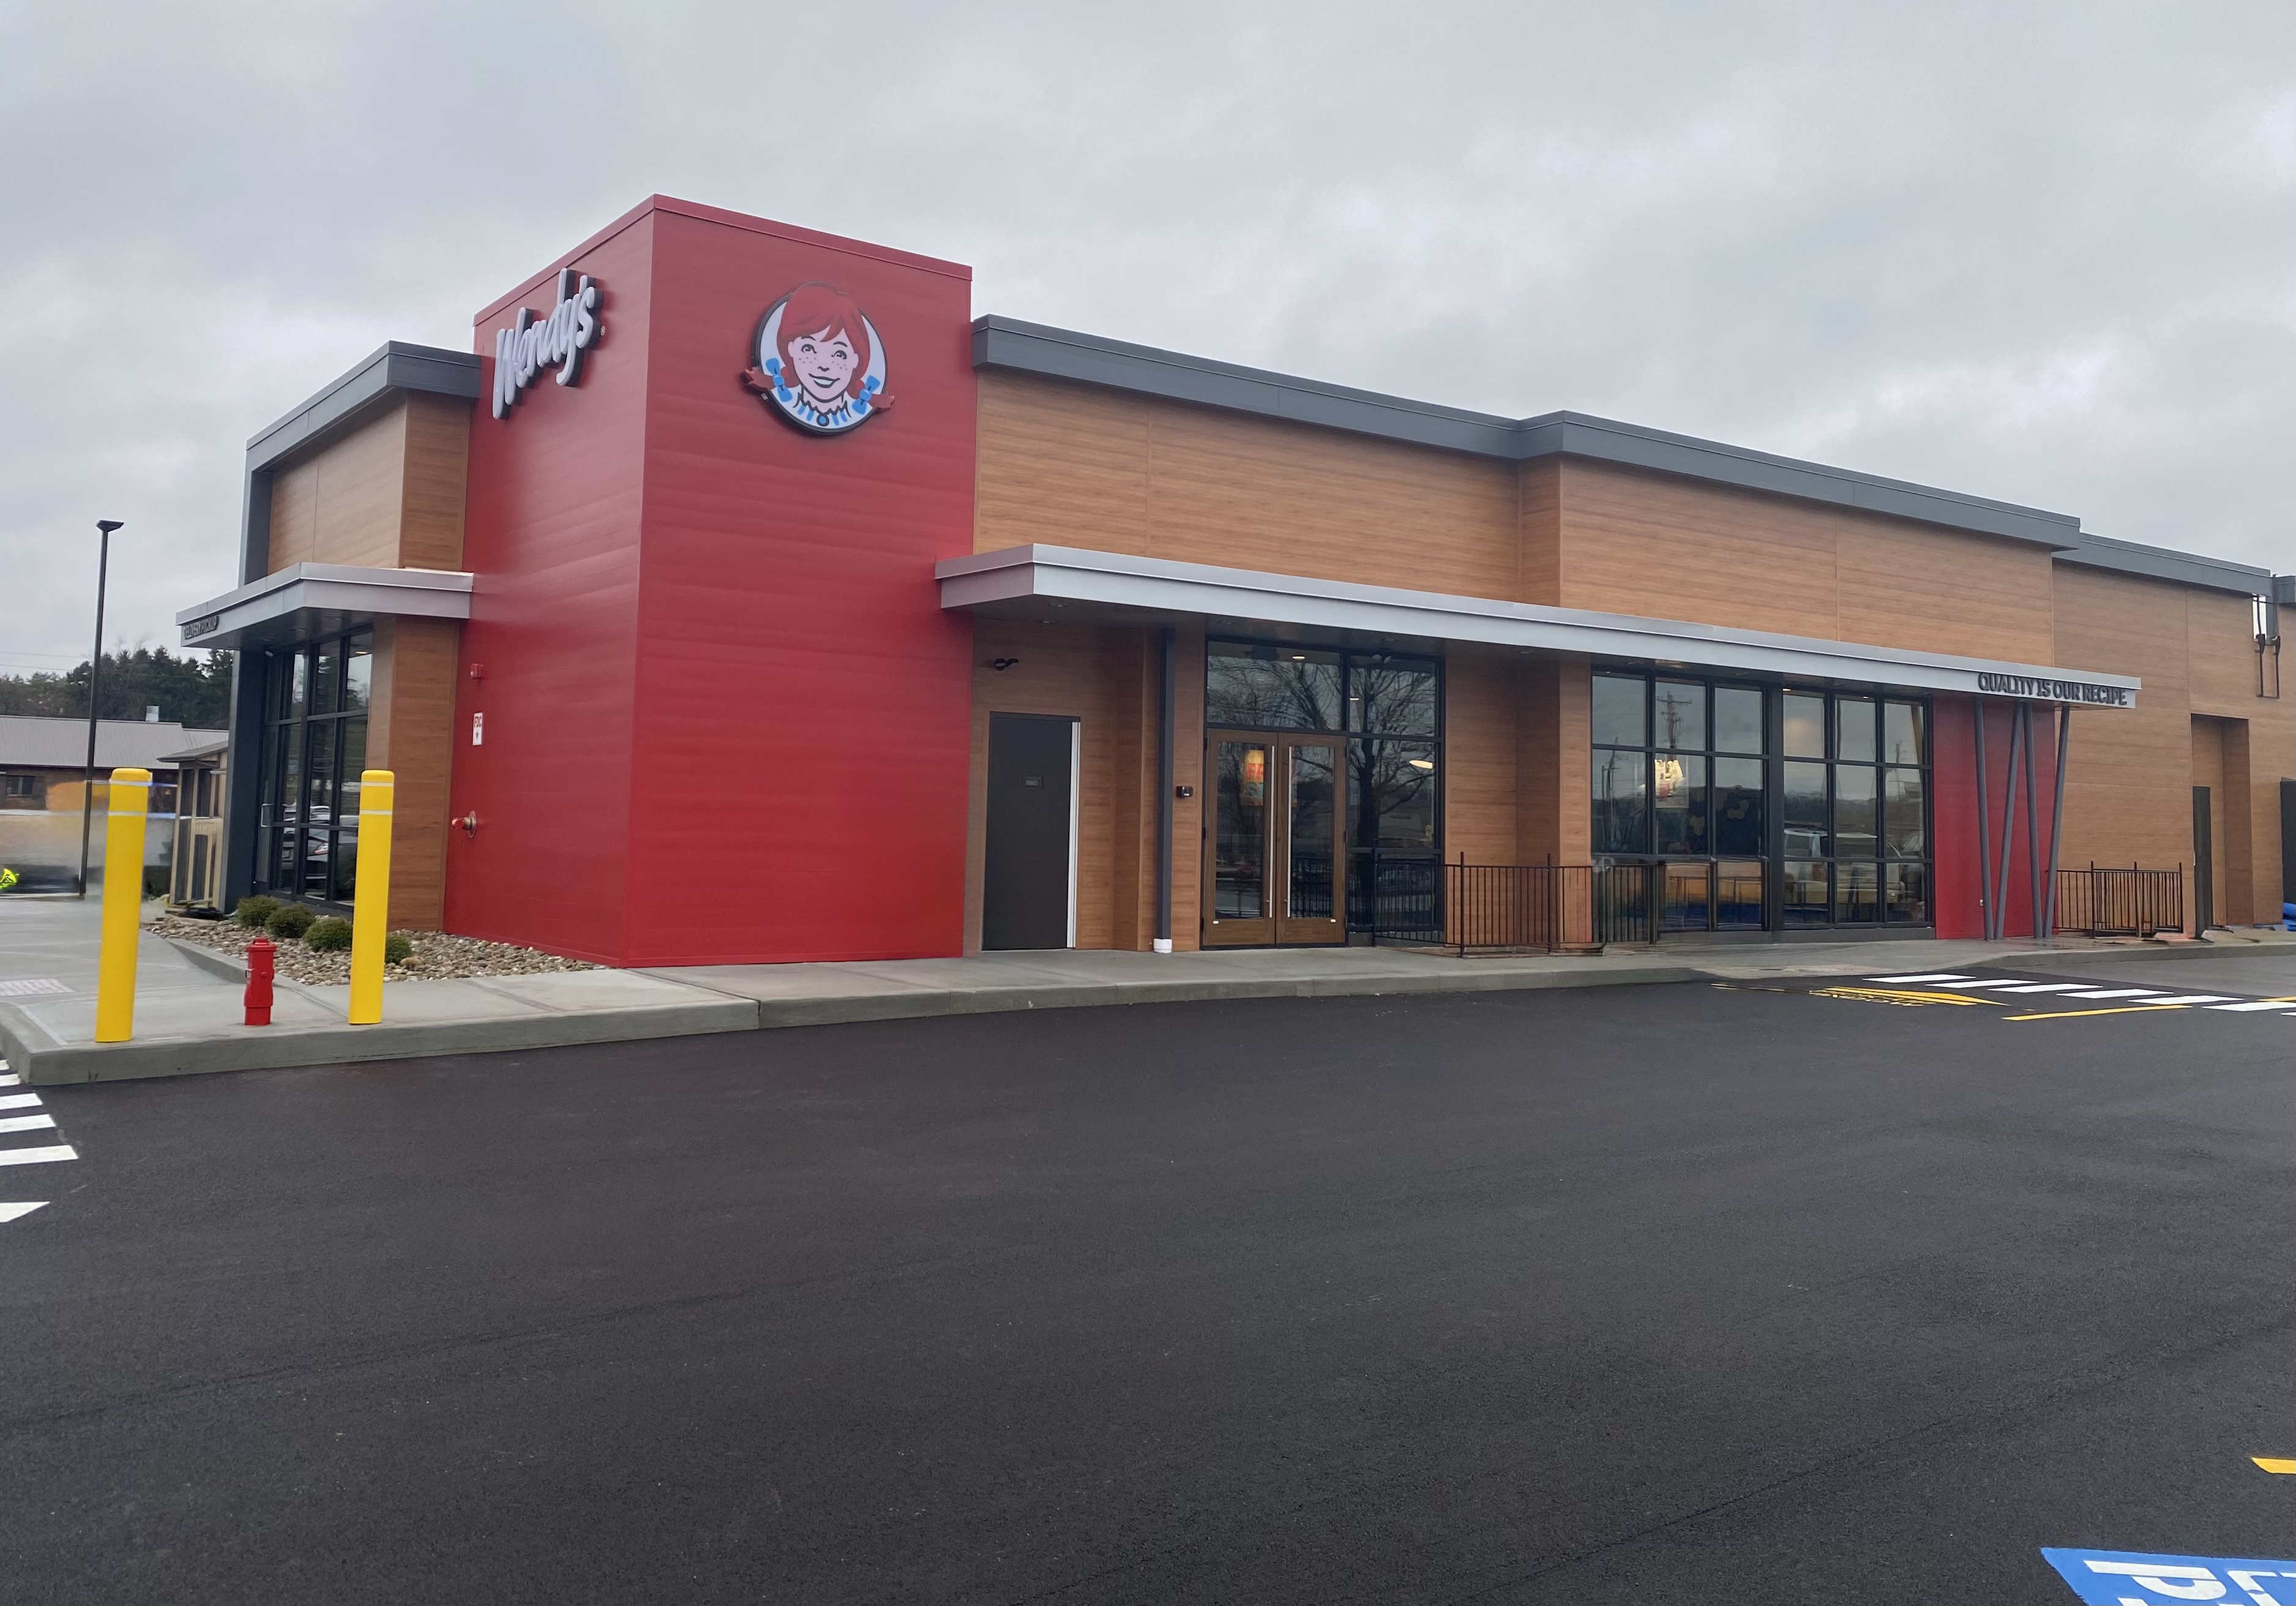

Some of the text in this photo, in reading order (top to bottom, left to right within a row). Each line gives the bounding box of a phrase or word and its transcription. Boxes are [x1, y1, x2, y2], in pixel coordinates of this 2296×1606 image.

[493, 268, 596, 419] Wendy's
[1978, 673, 2127, 705] QUALITY IS OUR RECIPE
